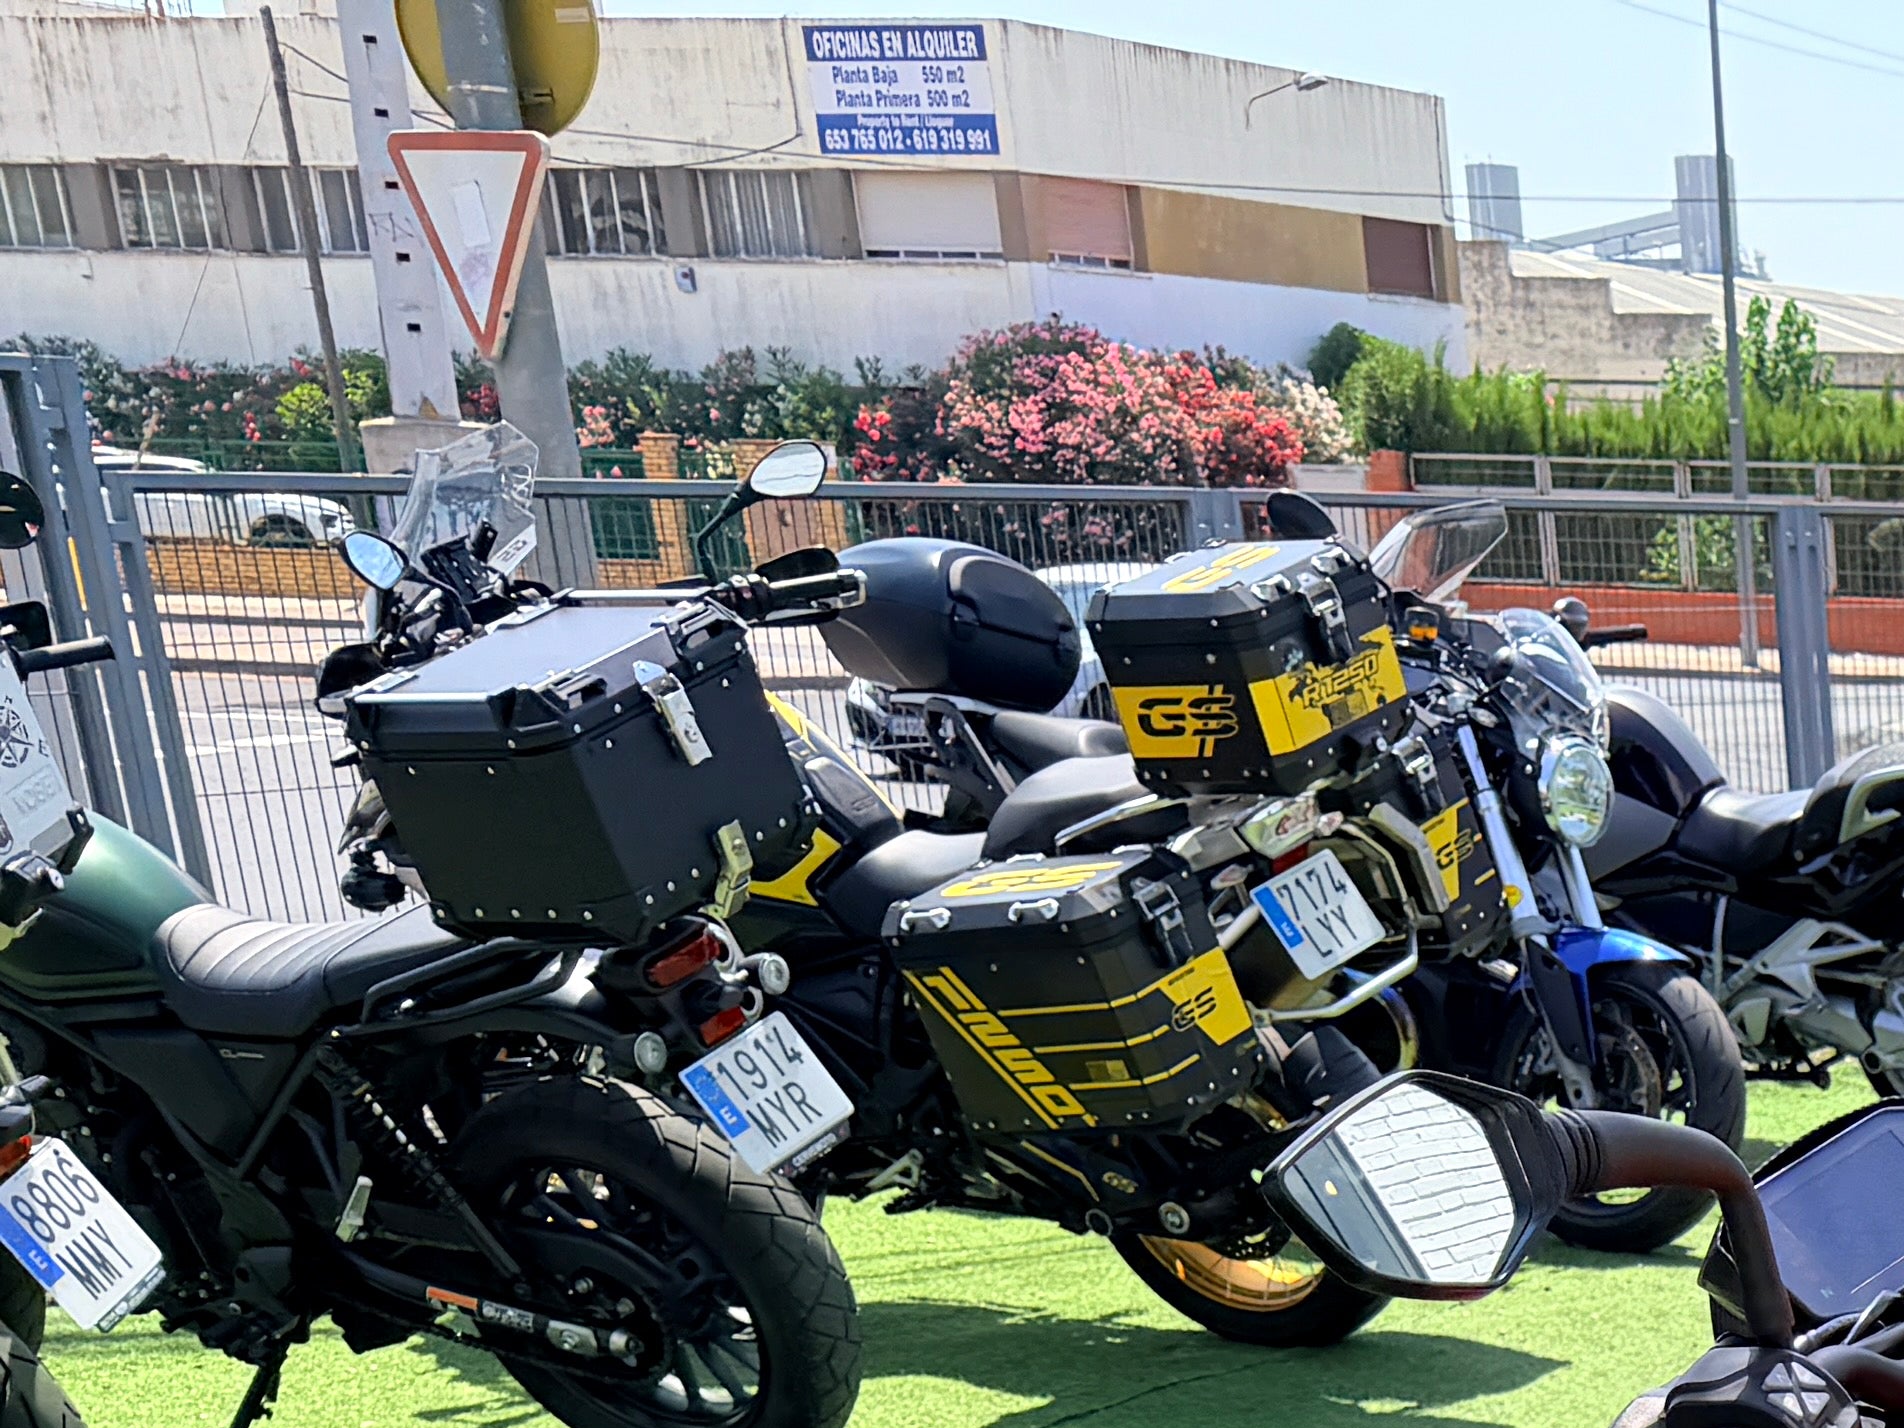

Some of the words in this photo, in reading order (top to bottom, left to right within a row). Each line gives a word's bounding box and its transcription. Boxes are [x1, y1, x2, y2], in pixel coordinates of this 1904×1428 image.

[812, 30, 880, 59] OFICINAS
[881, 30, 904, 58] EN
[907, 30, 979, 58] ALQUILER
[832, 66, 869, 84] Planta
[872, 65, 898, 87] Baja
[922, 66, 943, 83] 550
[947, 66, 965, 83] m2
[836, 89, 873, 108] Planta
[875, 89, 921, 108] Primera
[927, 90, 948, 107] 500
[952, 90, 970, 107] m2
[825, 129, 849, 150] 653
[851, 129, 876, 150] 765
[878, 129, 904, 150] 012
[913, 129, 938, 150] 619
[940, 129, 964, 150] 319
[967, 129, 991, 150] 991
[1137, 694, 1239, 738] GS
[1276, 861, 1347, 921] 7174
[1301, 904, 1357, 958] LYY
[717, 1026, 805, 1101] 1914
[745, 1082, 823, 1149] MYR
[11, 1157, 99, 1244] 8806
[55, 1218, 134, 1301] MMY
